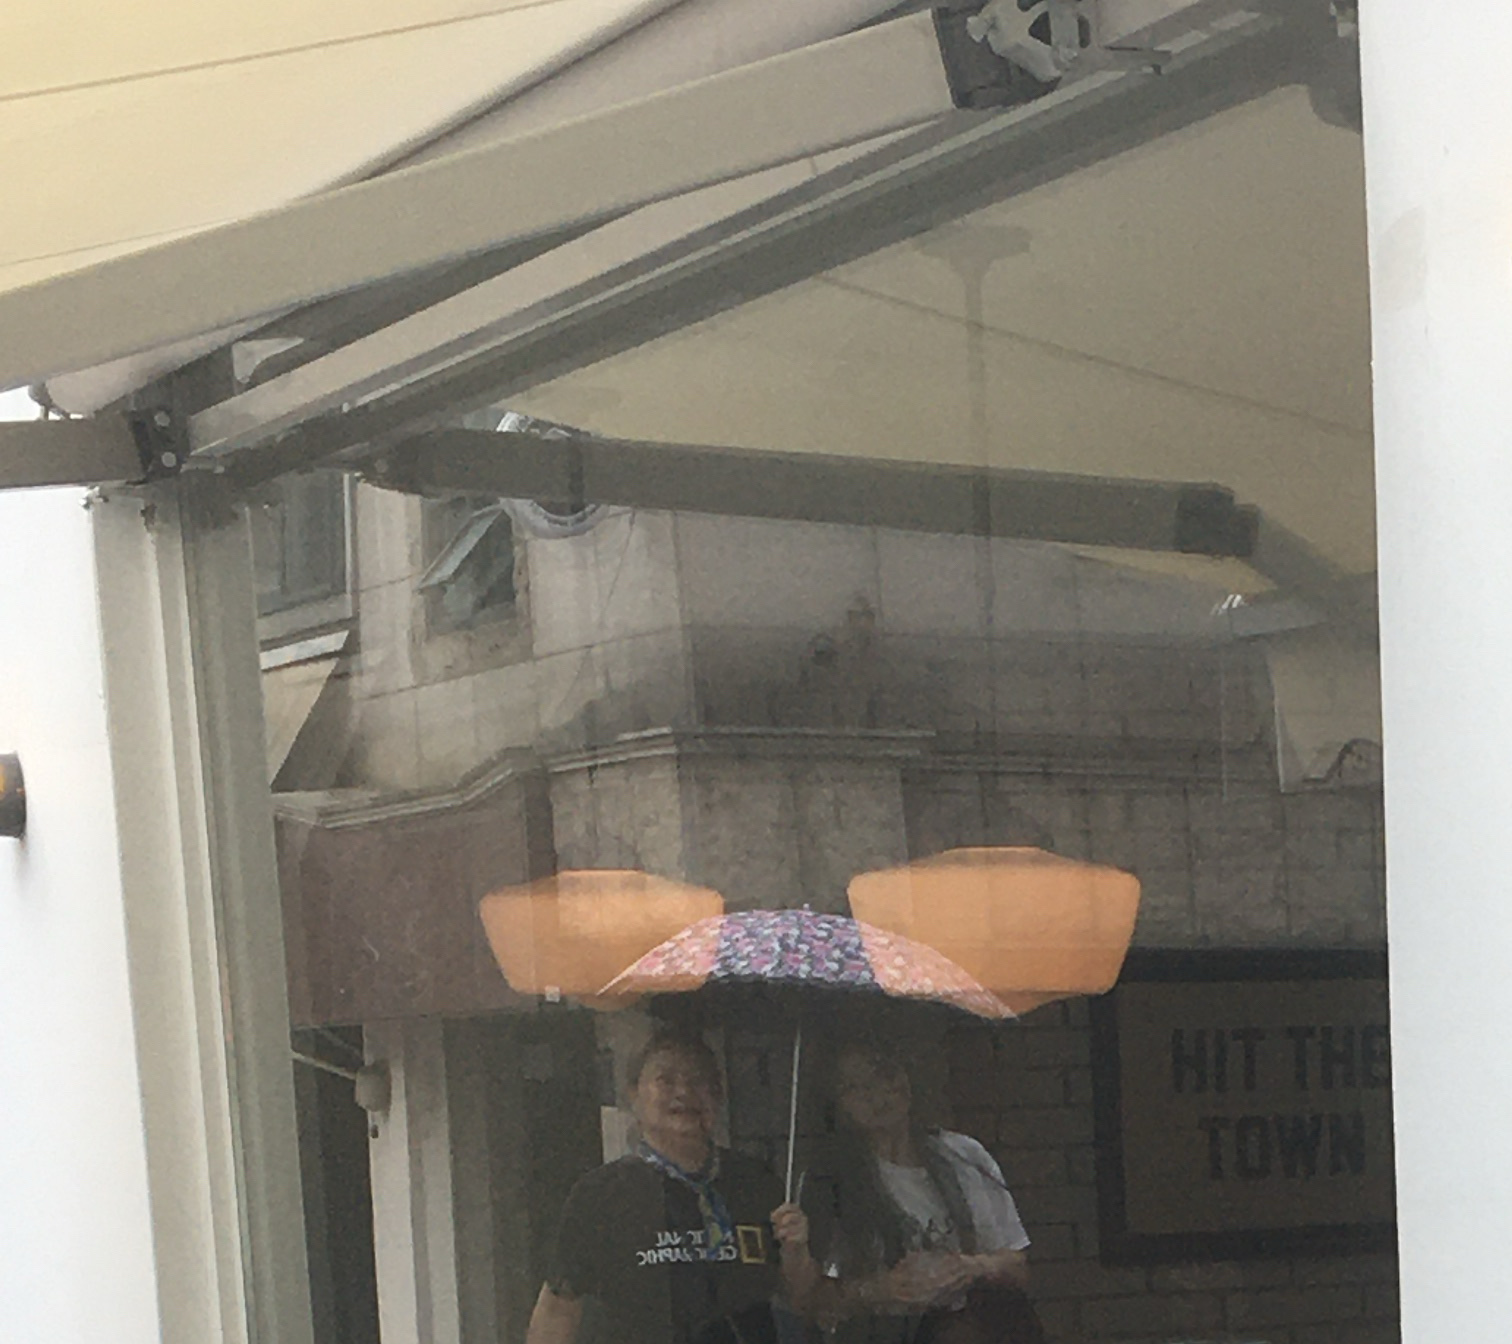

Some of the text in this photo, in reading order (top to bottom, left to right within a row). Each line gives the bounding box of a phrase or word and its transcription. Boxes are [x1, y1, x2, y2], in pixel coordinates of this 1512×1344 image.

[1171, 1025, 1389, 1094] HIT THE
[1199, 1112, 1365, 1180] TOWN
